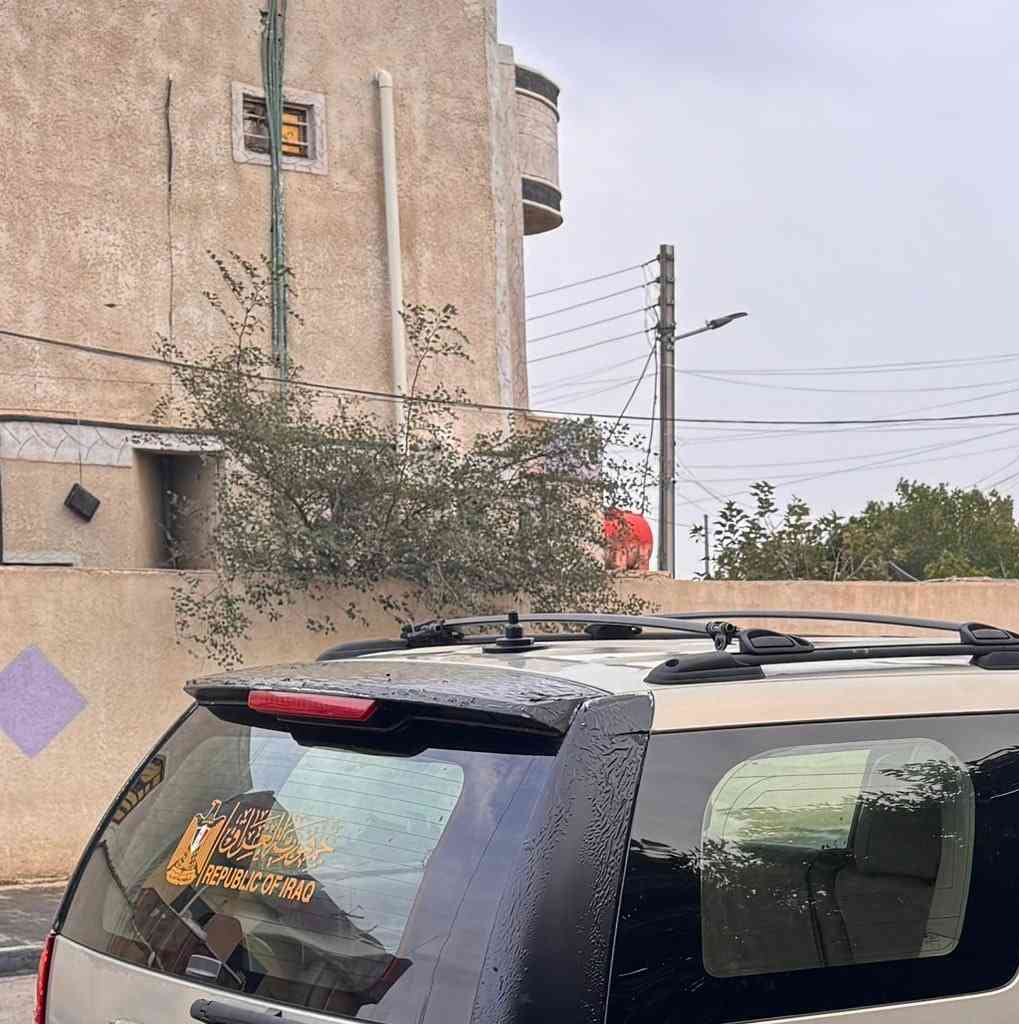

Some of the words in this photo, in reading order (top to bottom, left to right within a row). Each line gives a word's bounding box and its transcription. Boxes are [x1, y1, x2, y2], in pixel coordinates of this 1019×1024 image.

[202, 864, 258, 892] REPUBLIC
[261, 875, 282, 896] OF
[280, 876, 316, 904] IRAQ
